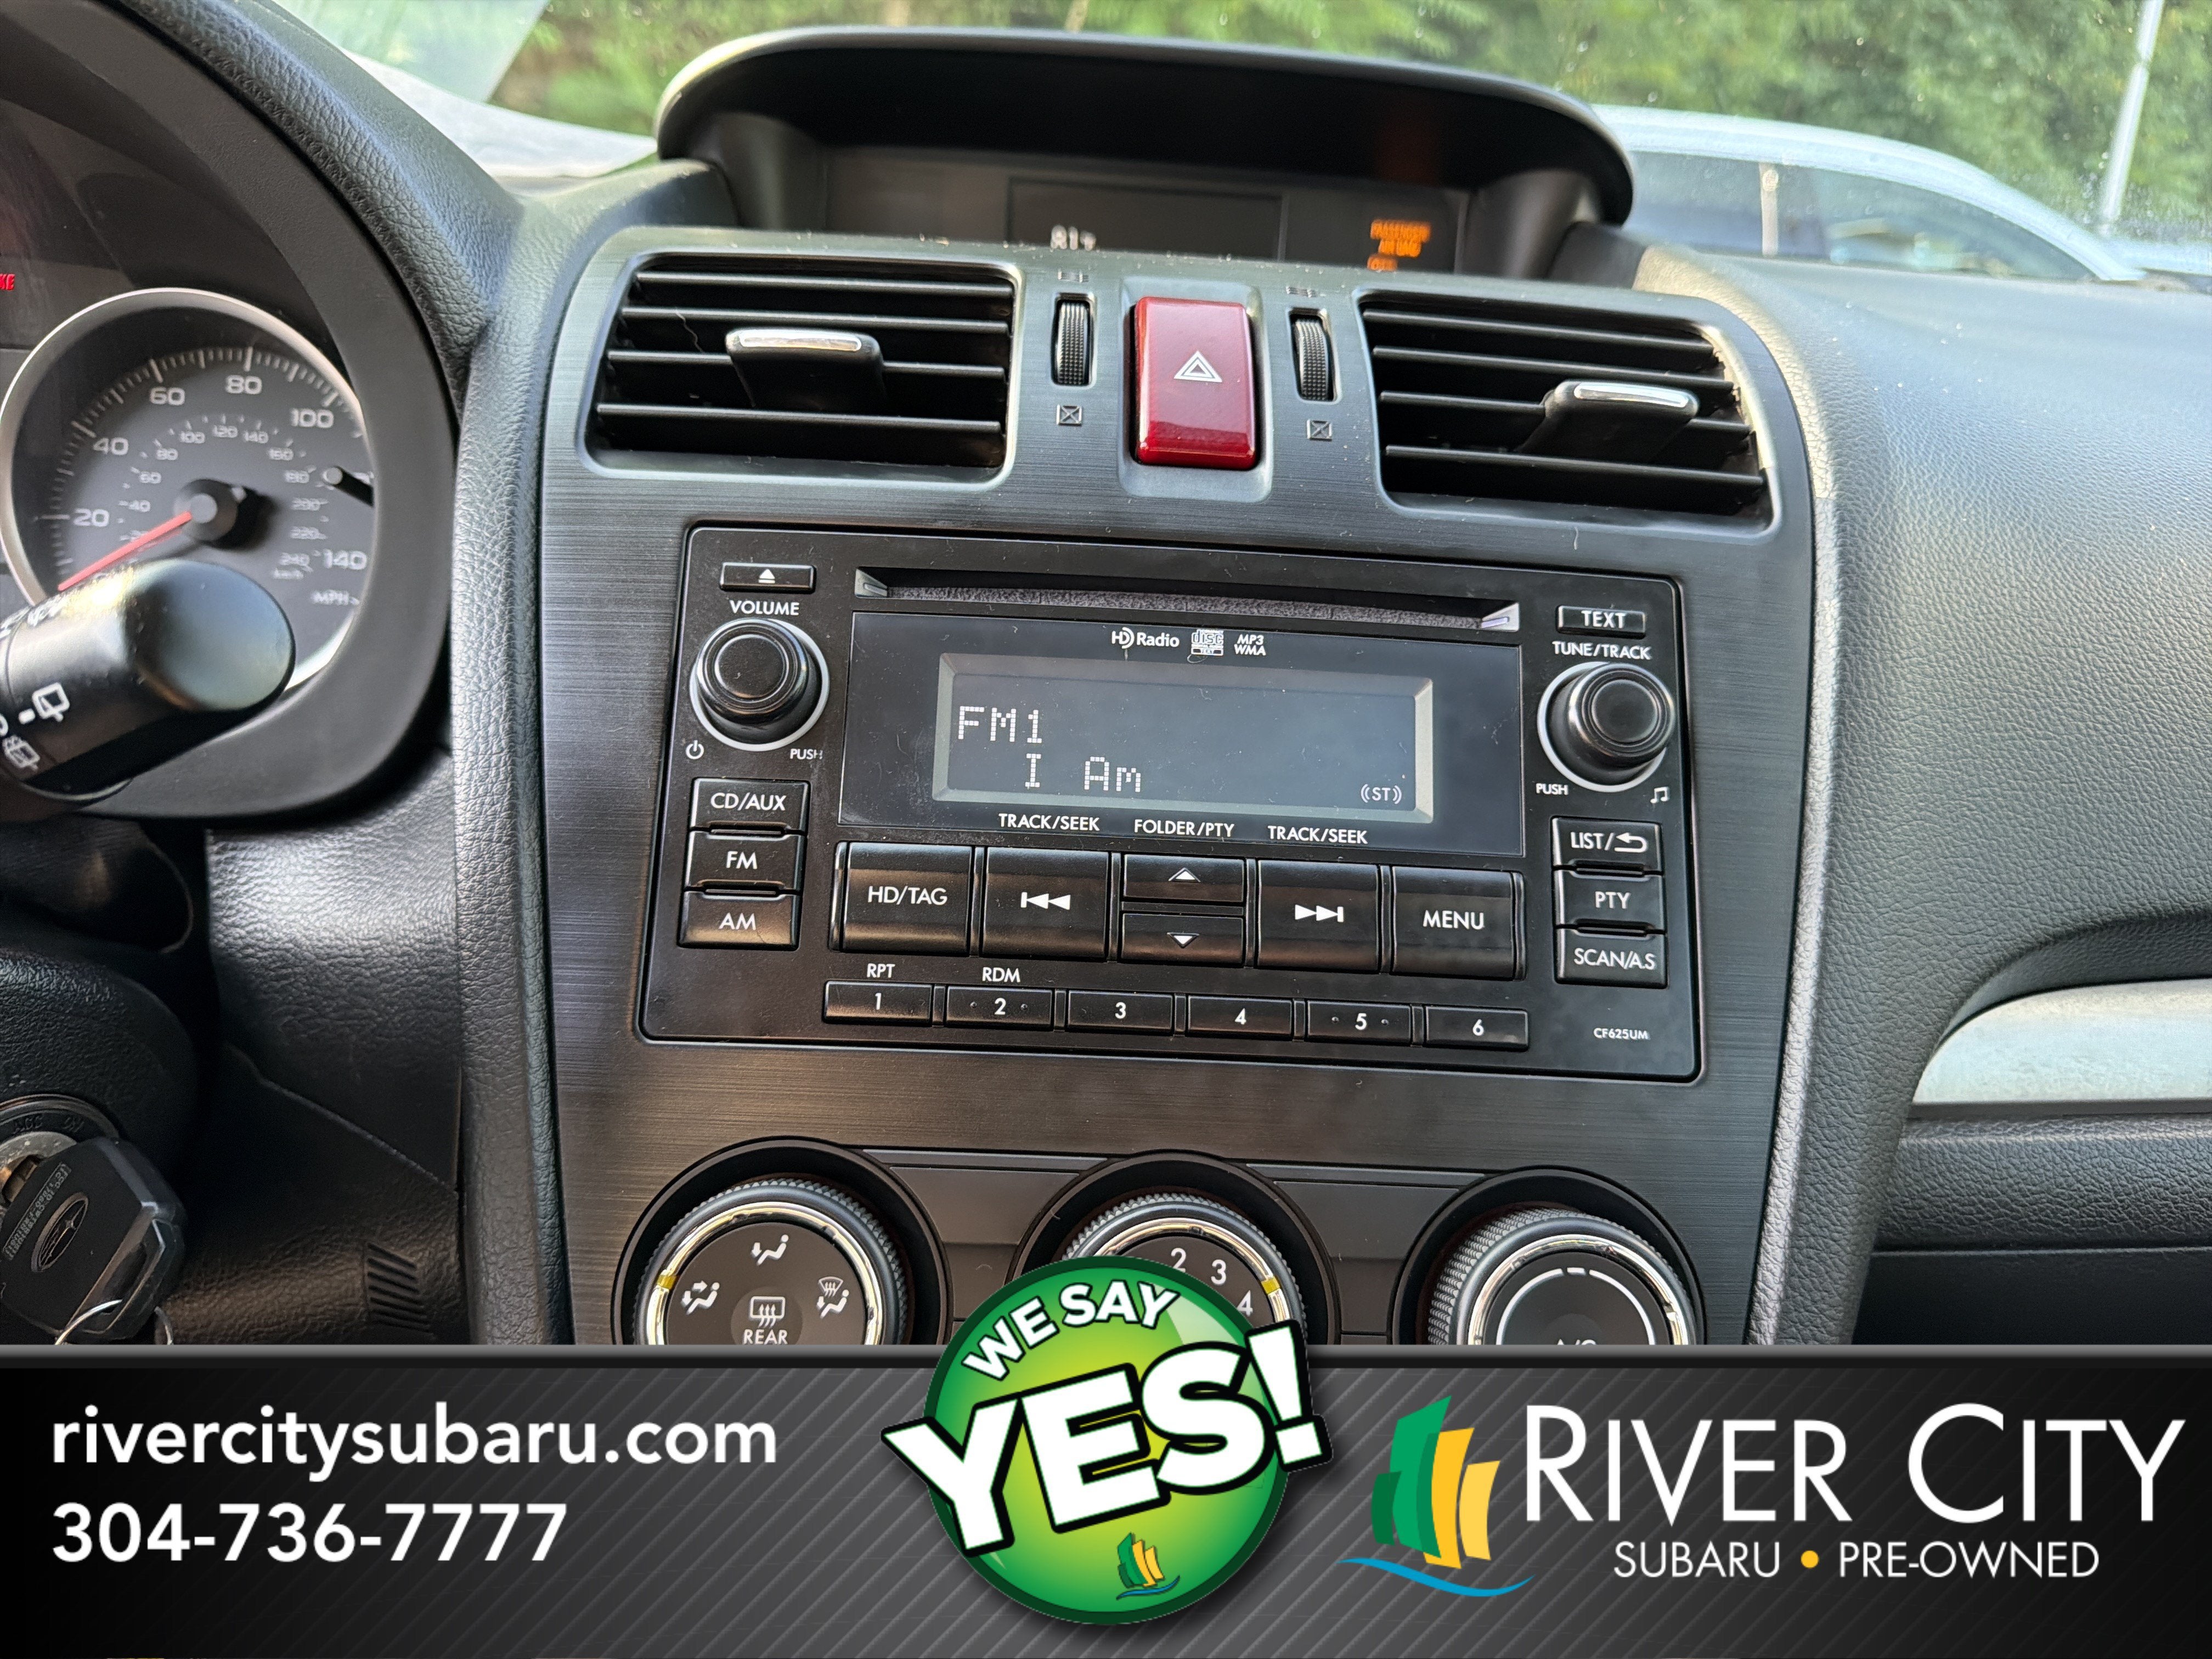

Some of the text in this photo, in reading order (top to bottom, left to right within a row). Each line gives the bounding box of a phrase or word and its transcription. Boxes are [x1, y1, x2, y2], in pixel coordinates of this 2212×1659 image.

[225, 375, 262, 395] 80
[150, 387, 185, 406] 60
[291, 409, 334, 428] 100
[180, 431, 205, 444] 100
[212, 426, 238, 438] 120
[94, 437, 130, 456] 40
[75, 509, 110, 527] 20
[324, 550, 367, 570] 140
[730, 600, 800, 616] VOLUME
[1581, 610, 1626, 629] TEXT
[1136, 632, 1180, 647] Radio
[1237, 634, 1264, 645] MP3
[1234, 645, 1266, 656] WMA
[1551, 641, 1651, 660] TUNE/TRACK
[958, 706, 1042, 744] FM1
[789, 748, 823, 760] PUSH
[1025, 753, 1141, 793] I Am
[1536, 783, 1568, 795] PUSH
[710, 792, 787, 811] CD/AUX
[998, 813, 1100, 831] TRACK/SEEK
[1134, 819, 1235, 837] FOLDER/PTY
[1267, 825, 1368, 844] TRACK/SEEK
[726, 850, 758, 870] FM
[867, 885, 947, 905] HD/TAG
[1595, 891, 1630, 909] PTY
[719, 913, 757, 930] AM
[1423, 910, 1485, 930] MENU
[866, 963, 896, 978] RPT
[982, 967, 1021, 983] RDM
[875, 992, 882, 1011] 1
[994, 997, 1006, 1015] 2
[1115, 1002, 1126, 1019] 3
[1234, 1008, 1246, 1025] 4
[1355, 1013, 1367, 1030] 5
[1472, 1019, 1484, 1036] 6
[1593, 1028, 1650, 1040] CF625UM
[1171, 1248, 1187, 1272] 2
[1211, 1259, 1227, 1285] 3
[1237, 1290, 1253, 1316] 4
[743, 1329, 788, 1345] REAR
